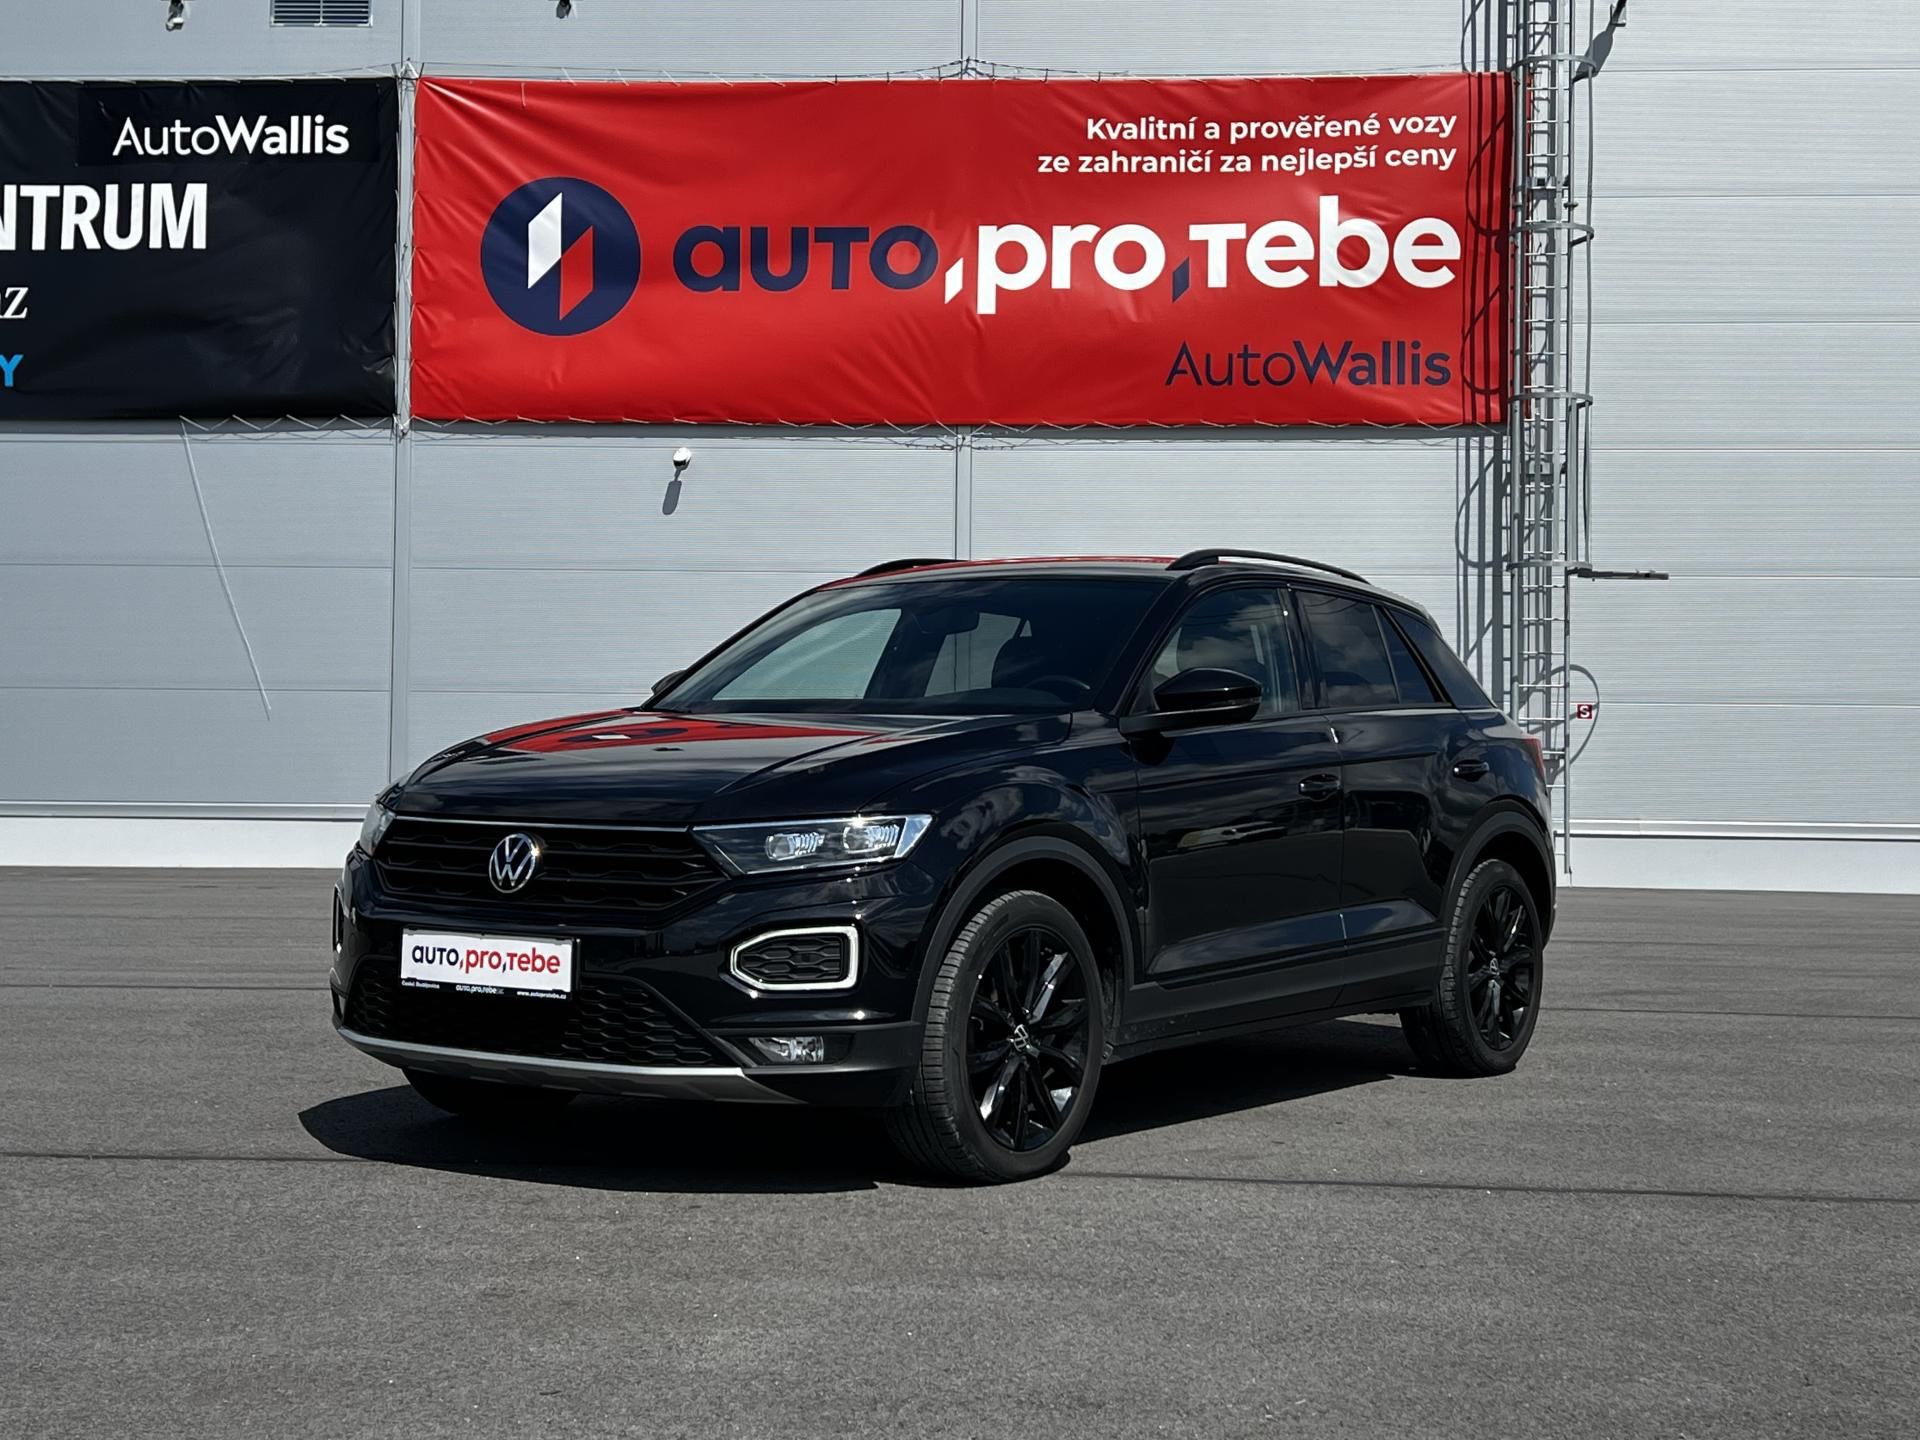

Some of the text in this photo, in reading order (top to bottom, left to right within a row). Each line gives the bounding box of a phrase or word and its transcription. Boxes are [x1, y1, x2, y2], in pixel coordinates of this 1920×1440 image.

[113, 114, 350, 157] AutoWallis
[1086, 114, 1457, 144] Kvalitní a prověřené vozy
[1037, 146, 1457, 176] ze zahraničí za nejlepší ceny
[1165, 340, 1451, 386] AutoWallis
